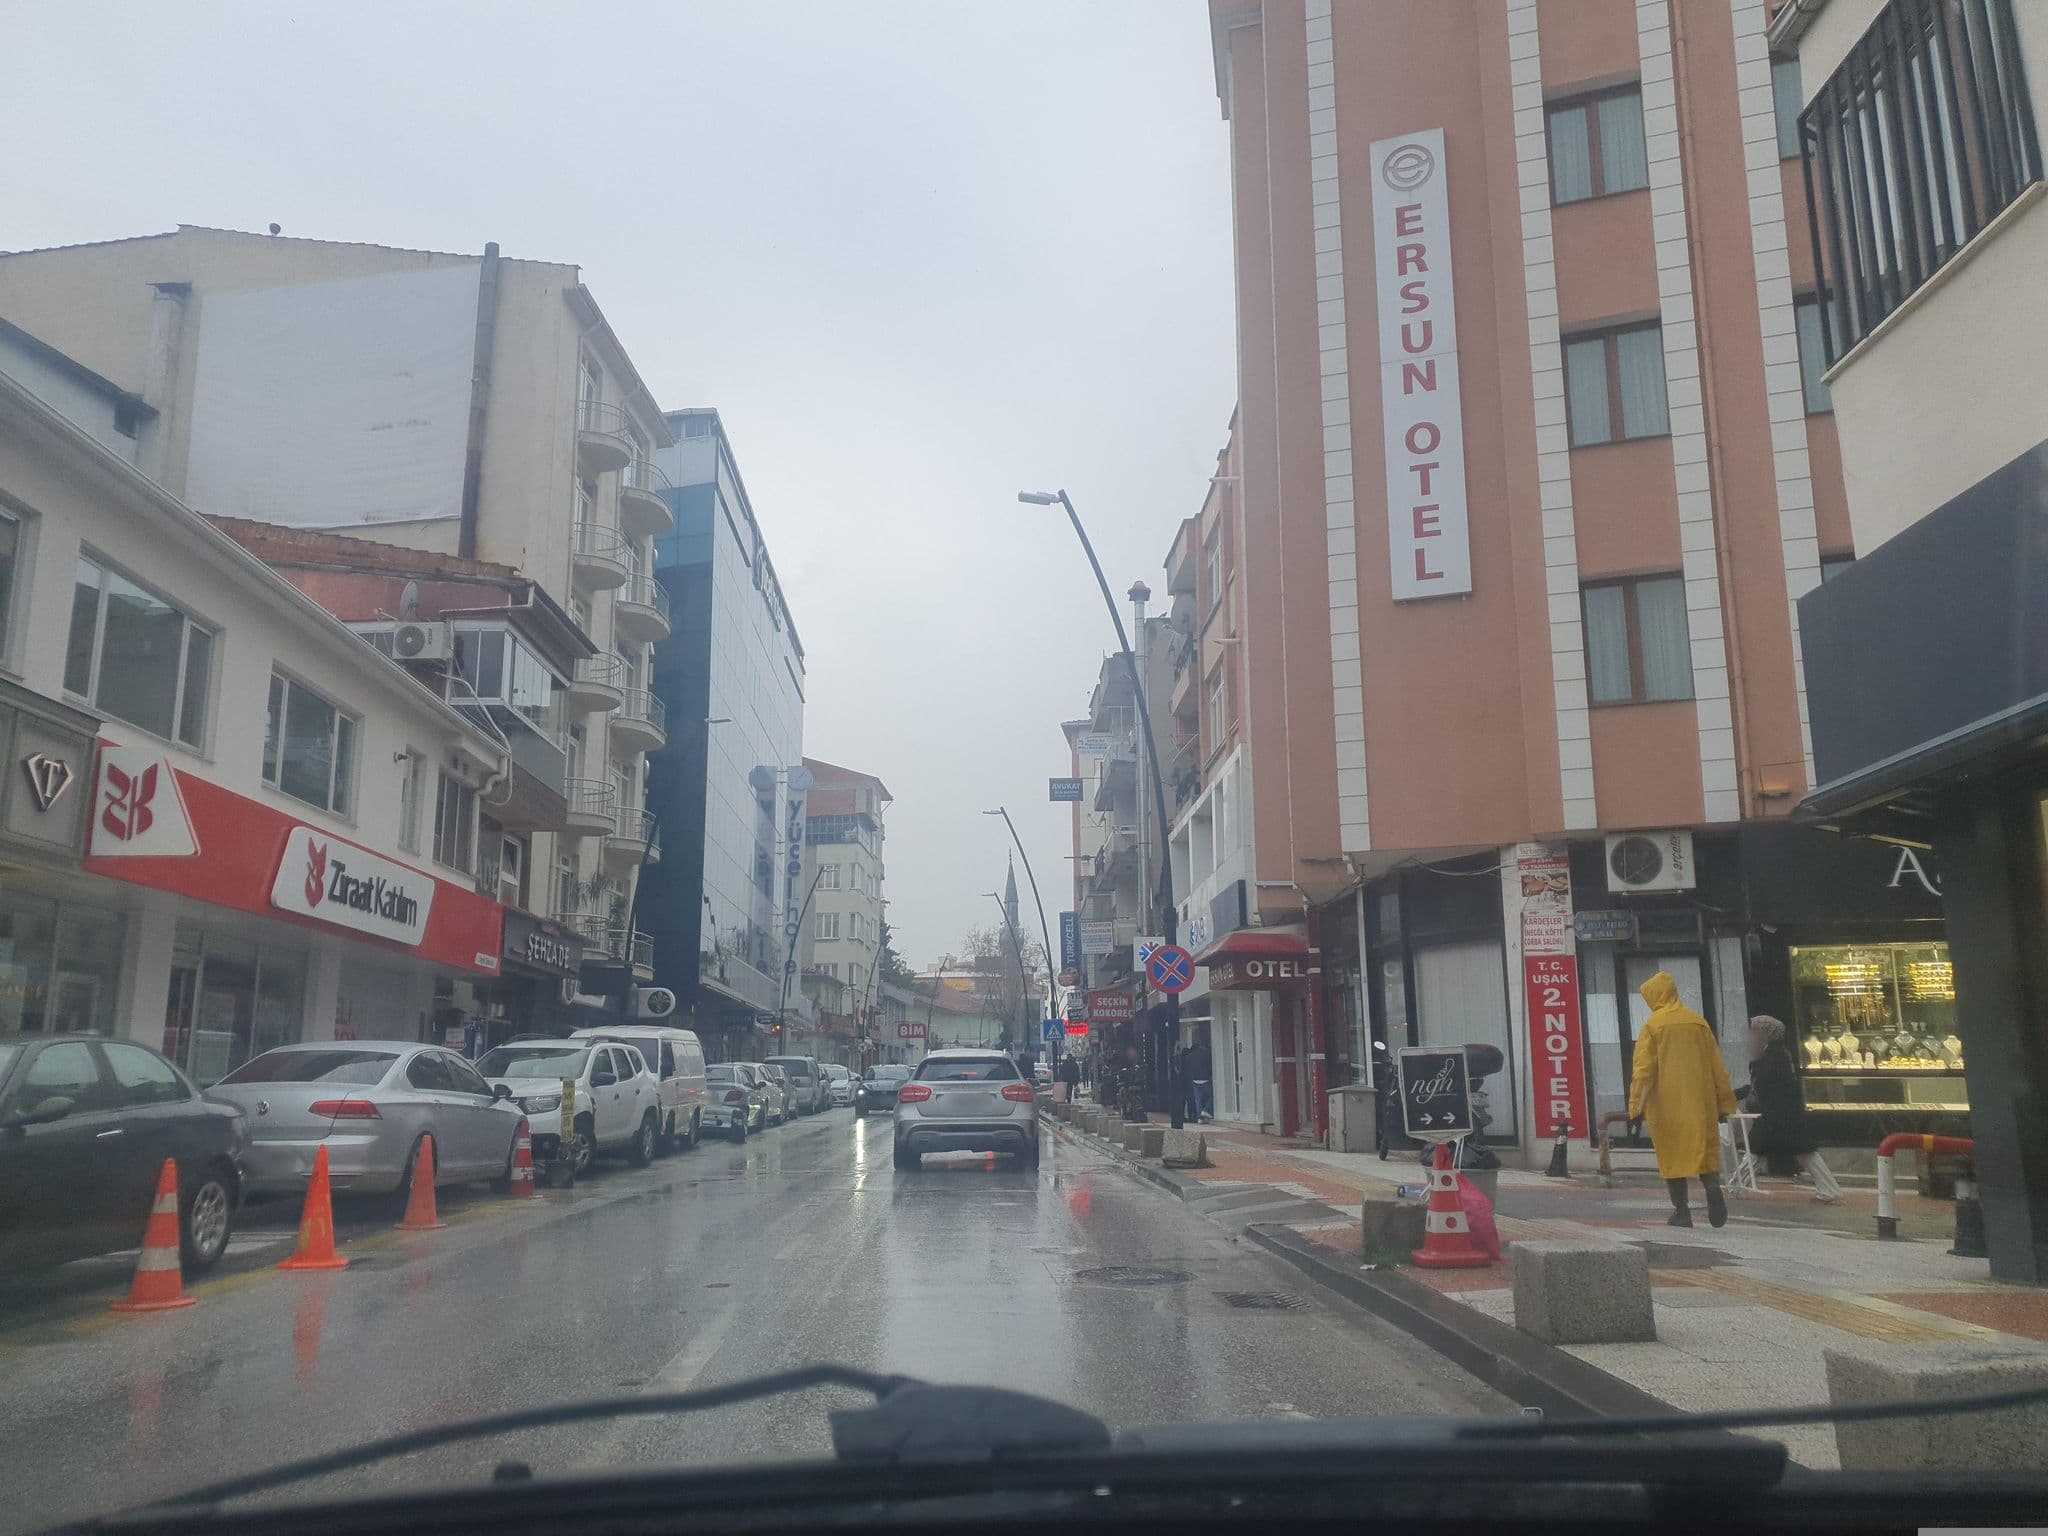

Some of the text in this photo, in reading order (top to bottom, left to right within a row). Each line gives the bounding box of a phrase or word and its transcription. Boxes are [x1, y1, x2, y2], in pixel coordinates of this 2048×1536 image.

[1395, 203, 1444, 582] ERSUN OTEL
[1669, 831, 1685, 871] arçelik
[327, 859, 374, 913] Ziraat
[527, 932, 570, 969] ŞEHZADE
[1066, 915, 1075, 963] TURKCELL
[1246, 960, 1306, 978] OTEL
[1532, 974, 1570, 986] UŞAK
[1543, 988, 1567, 1007] 2.
[900, 1022, 925, 1037] BİM
[1544, 1013, 1572, 1119] NOTER
